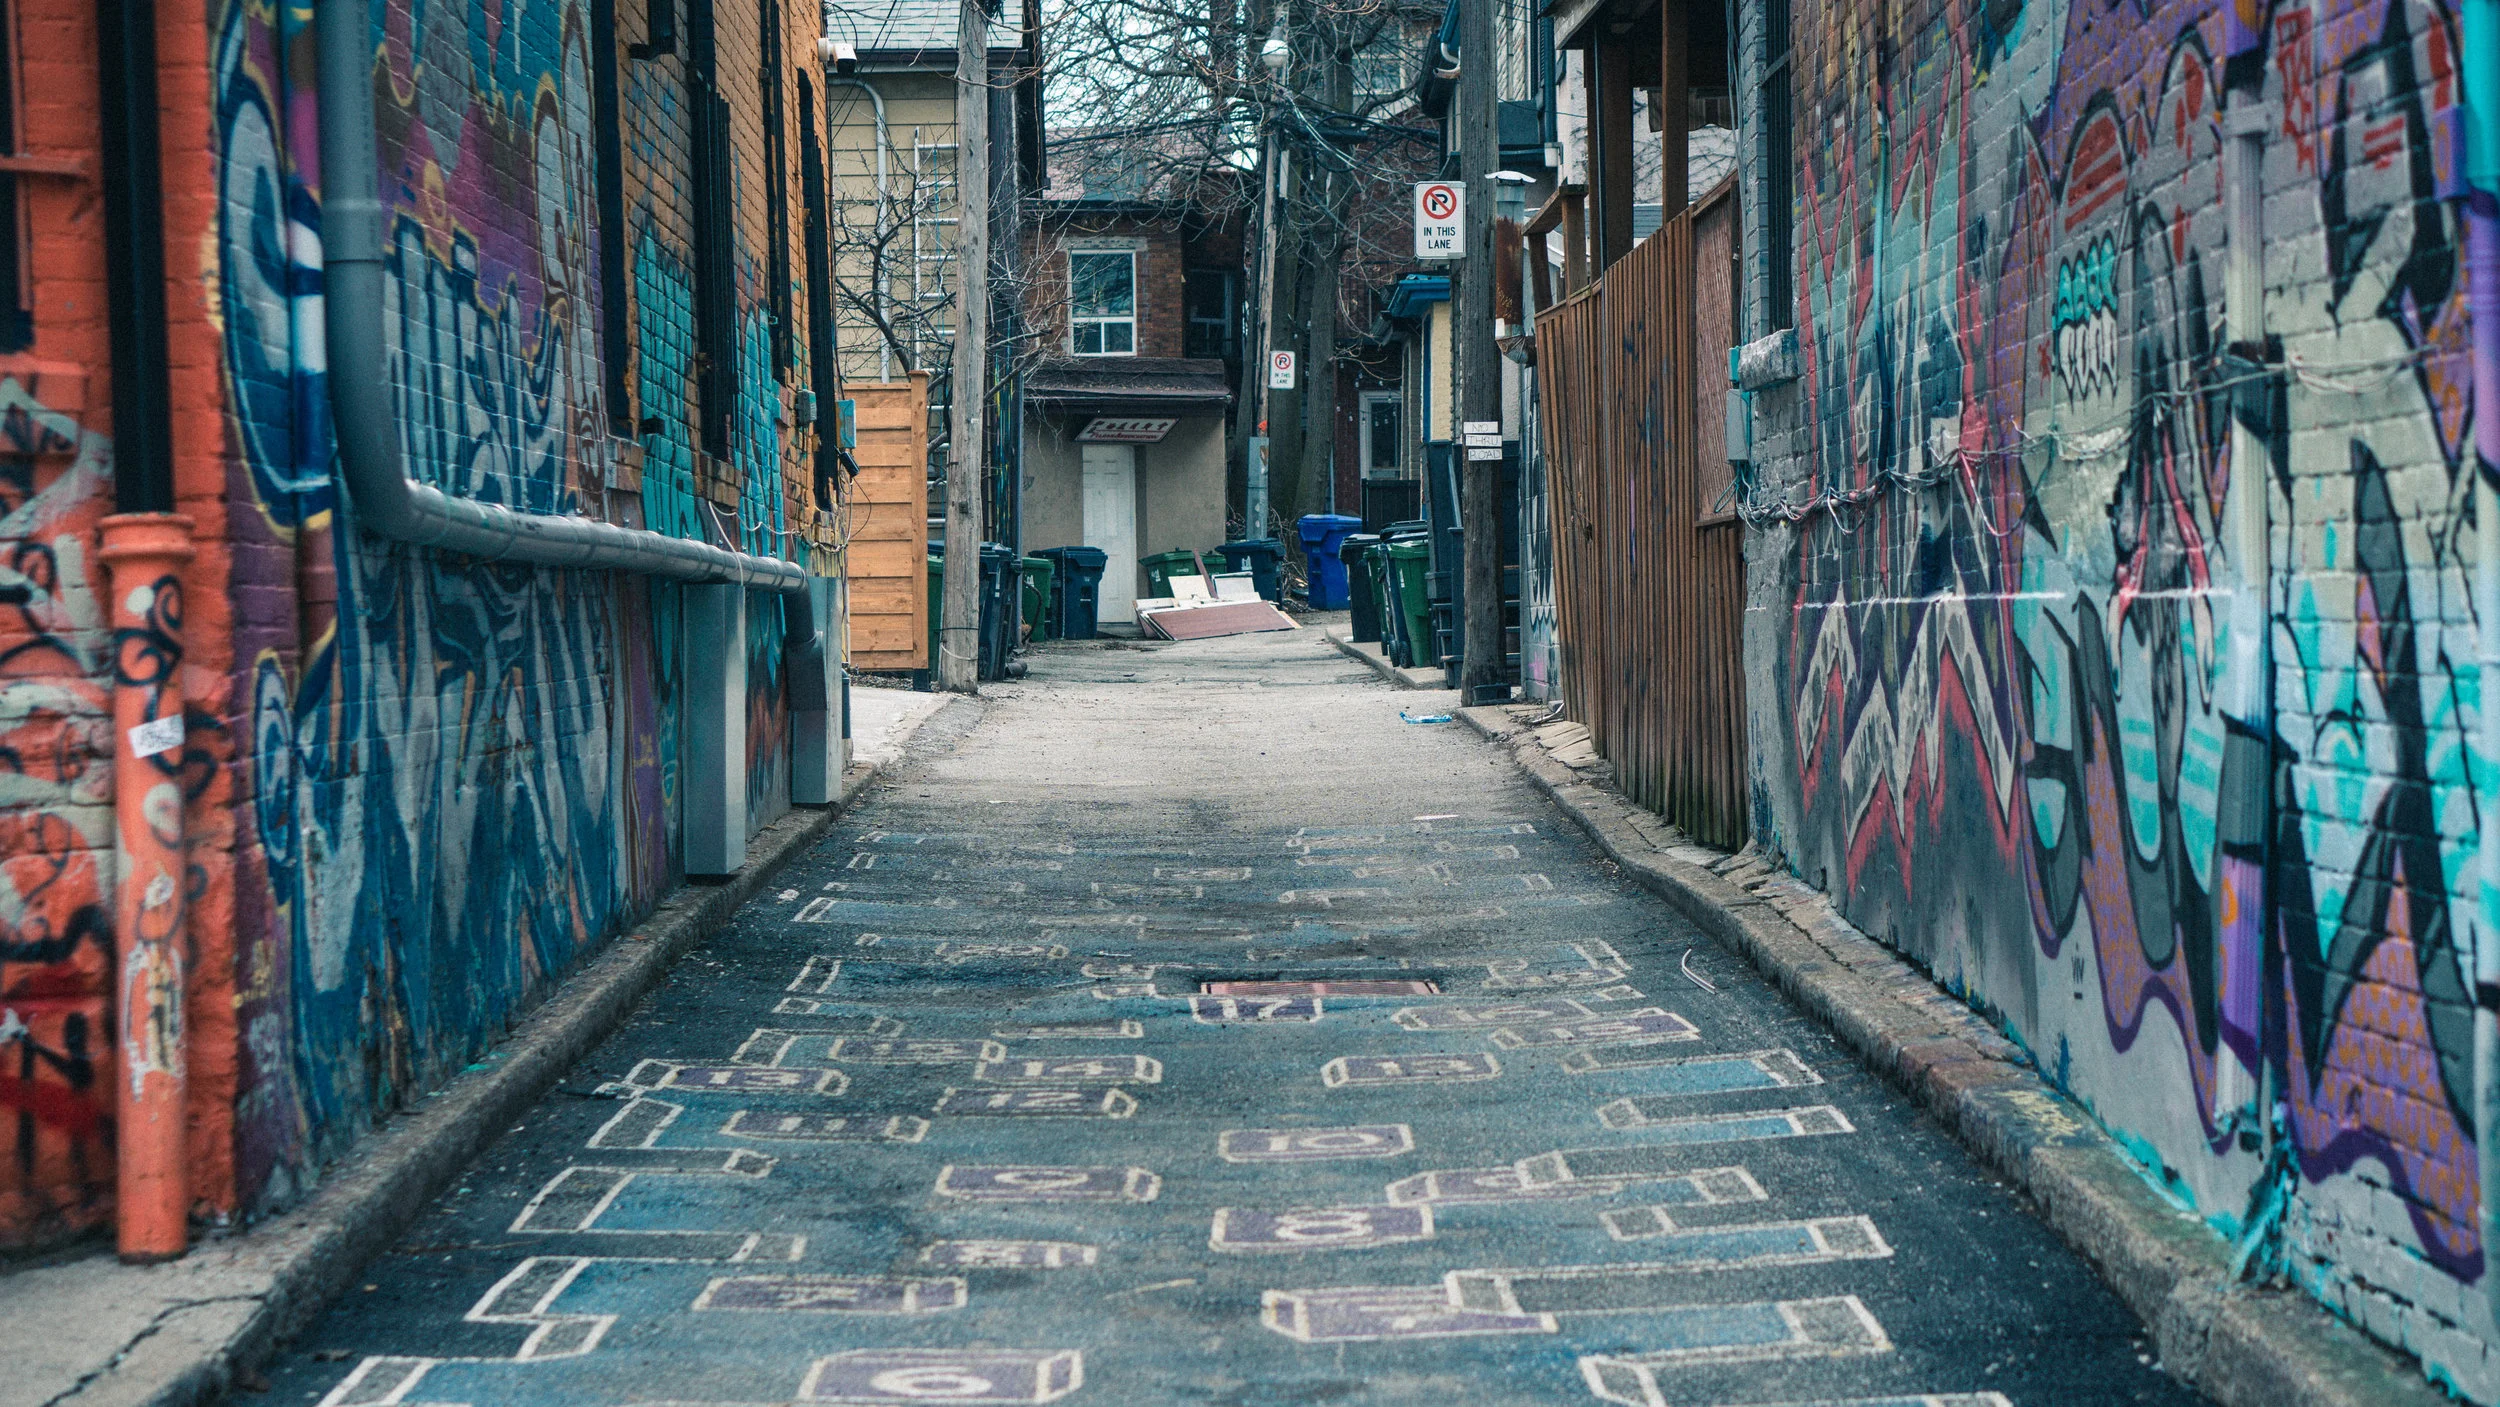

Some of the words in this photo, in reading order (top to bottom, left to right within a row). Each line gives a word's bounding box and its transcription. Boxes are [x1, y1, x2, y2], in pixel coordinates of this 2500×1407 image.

[1424, 227, 1432, 236] IN
[1437, 227, 1456, 236] THIS
[1428, 240, 1451, 249] LANE
[1472, 423, 1488, 432] NO
[1467, 436, 1499, 446] THRU
[1216, 998, 1293, 1020] 17
[1023, 1060, 1115, 1077] 14
[986, 1092, 1082, 1108] 12
[1268, 1131, 1384, 1151] 10
